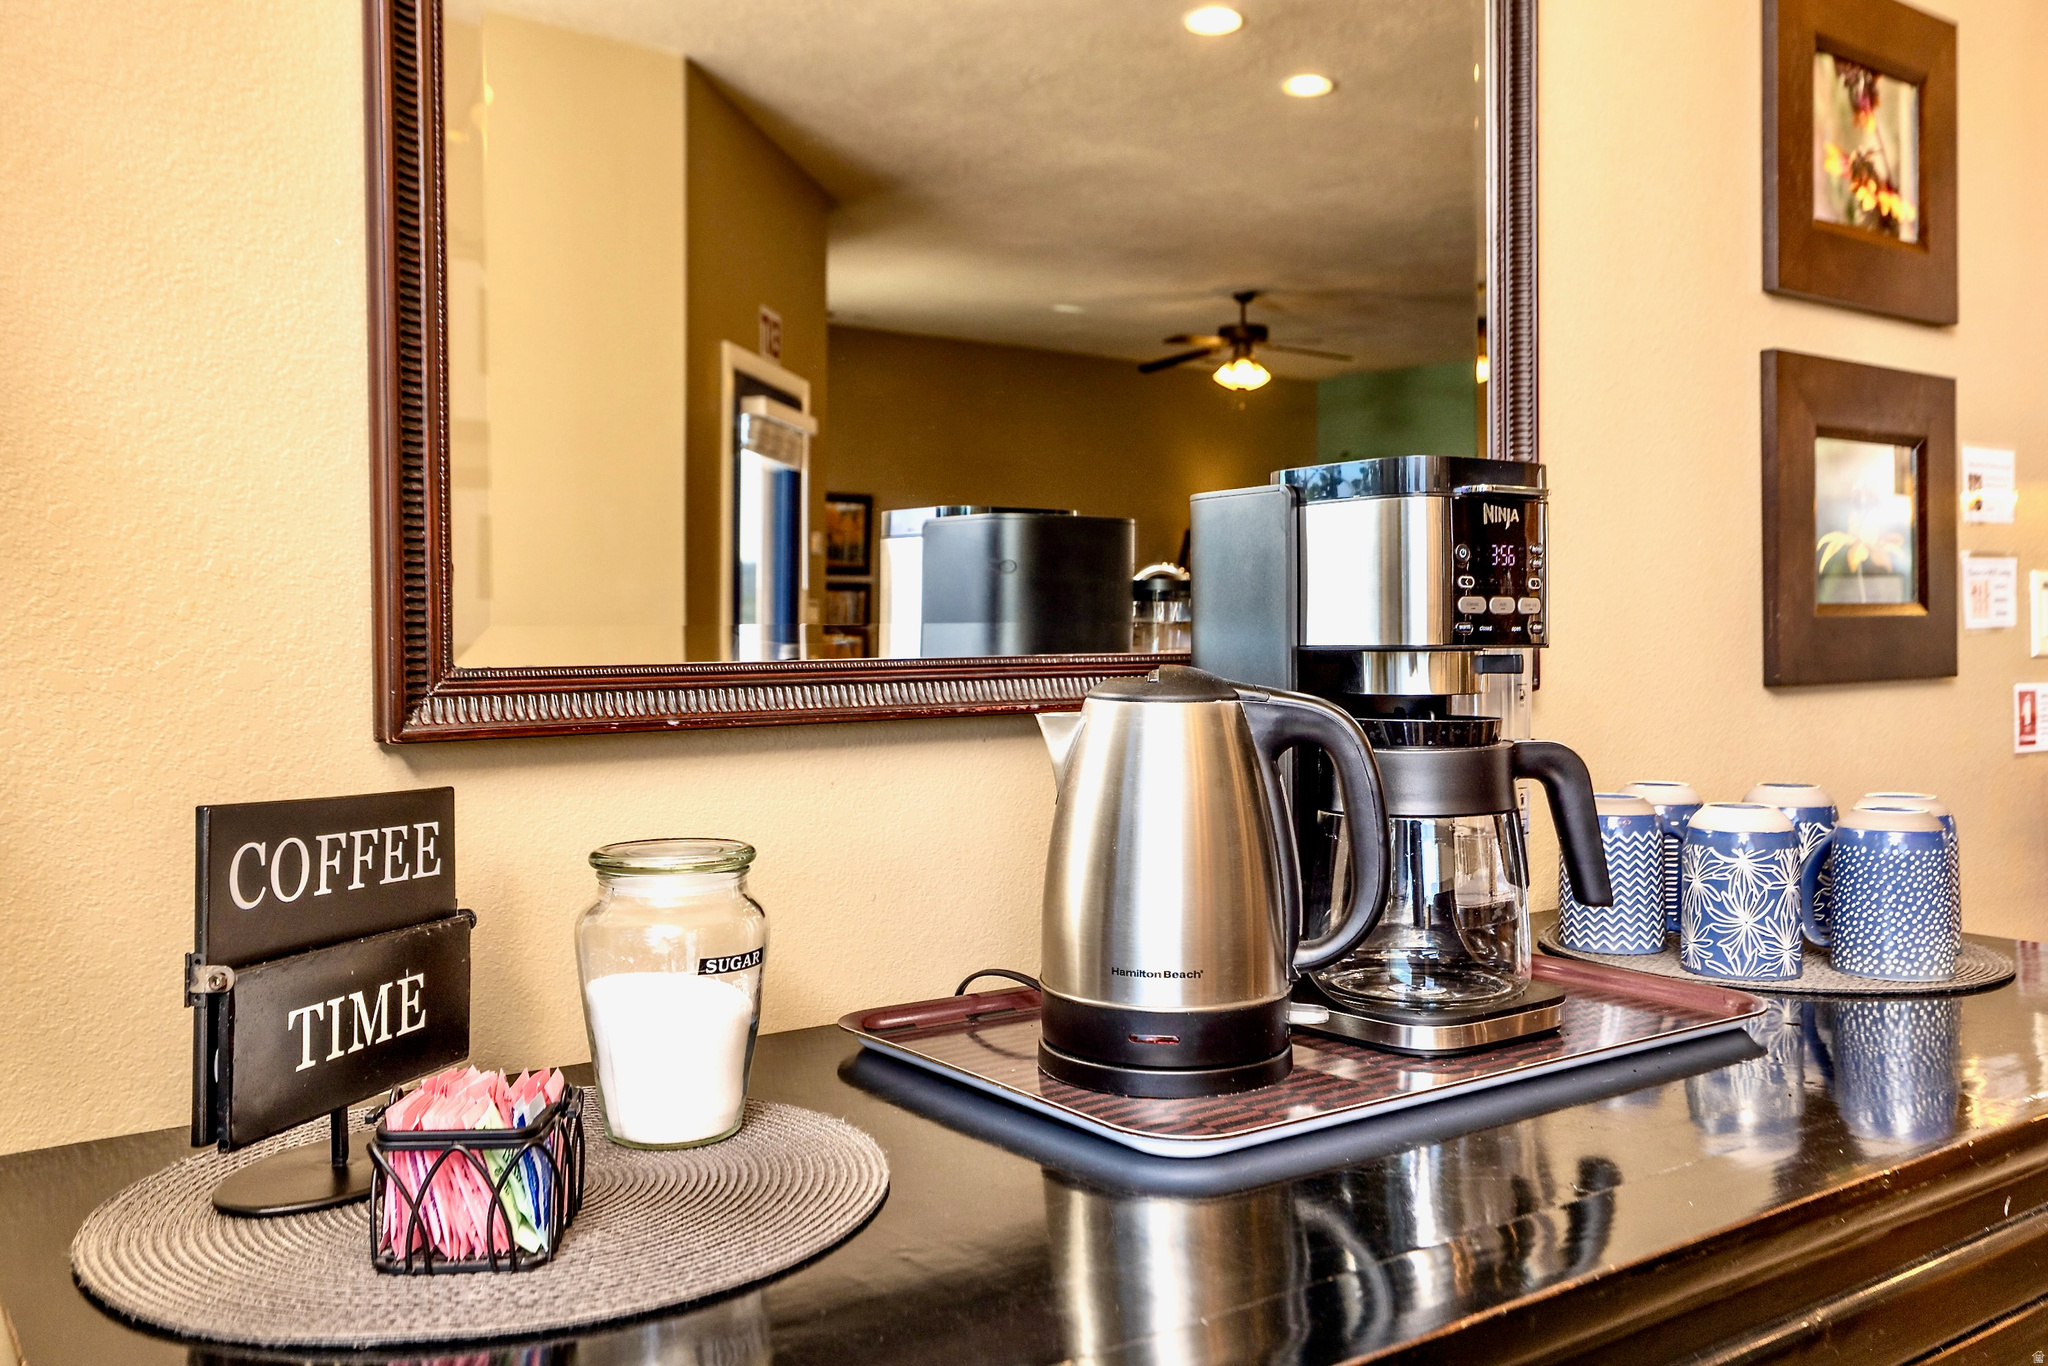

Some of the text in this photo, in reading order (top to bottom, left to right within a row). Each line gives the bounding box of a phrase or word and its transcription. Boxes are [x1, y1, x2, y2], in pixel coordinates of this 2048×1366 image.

[1483, 502, 1519, 530] NINJA
[1491, 544, 1516, 566] 3:56
[229, 821, 441, 910] COFFEE
[705, 951, 760, 973] SUGAR
[1111, 967, 1202, 979] Hamilton Beach
[287, 973, 426, 1073] TIME
